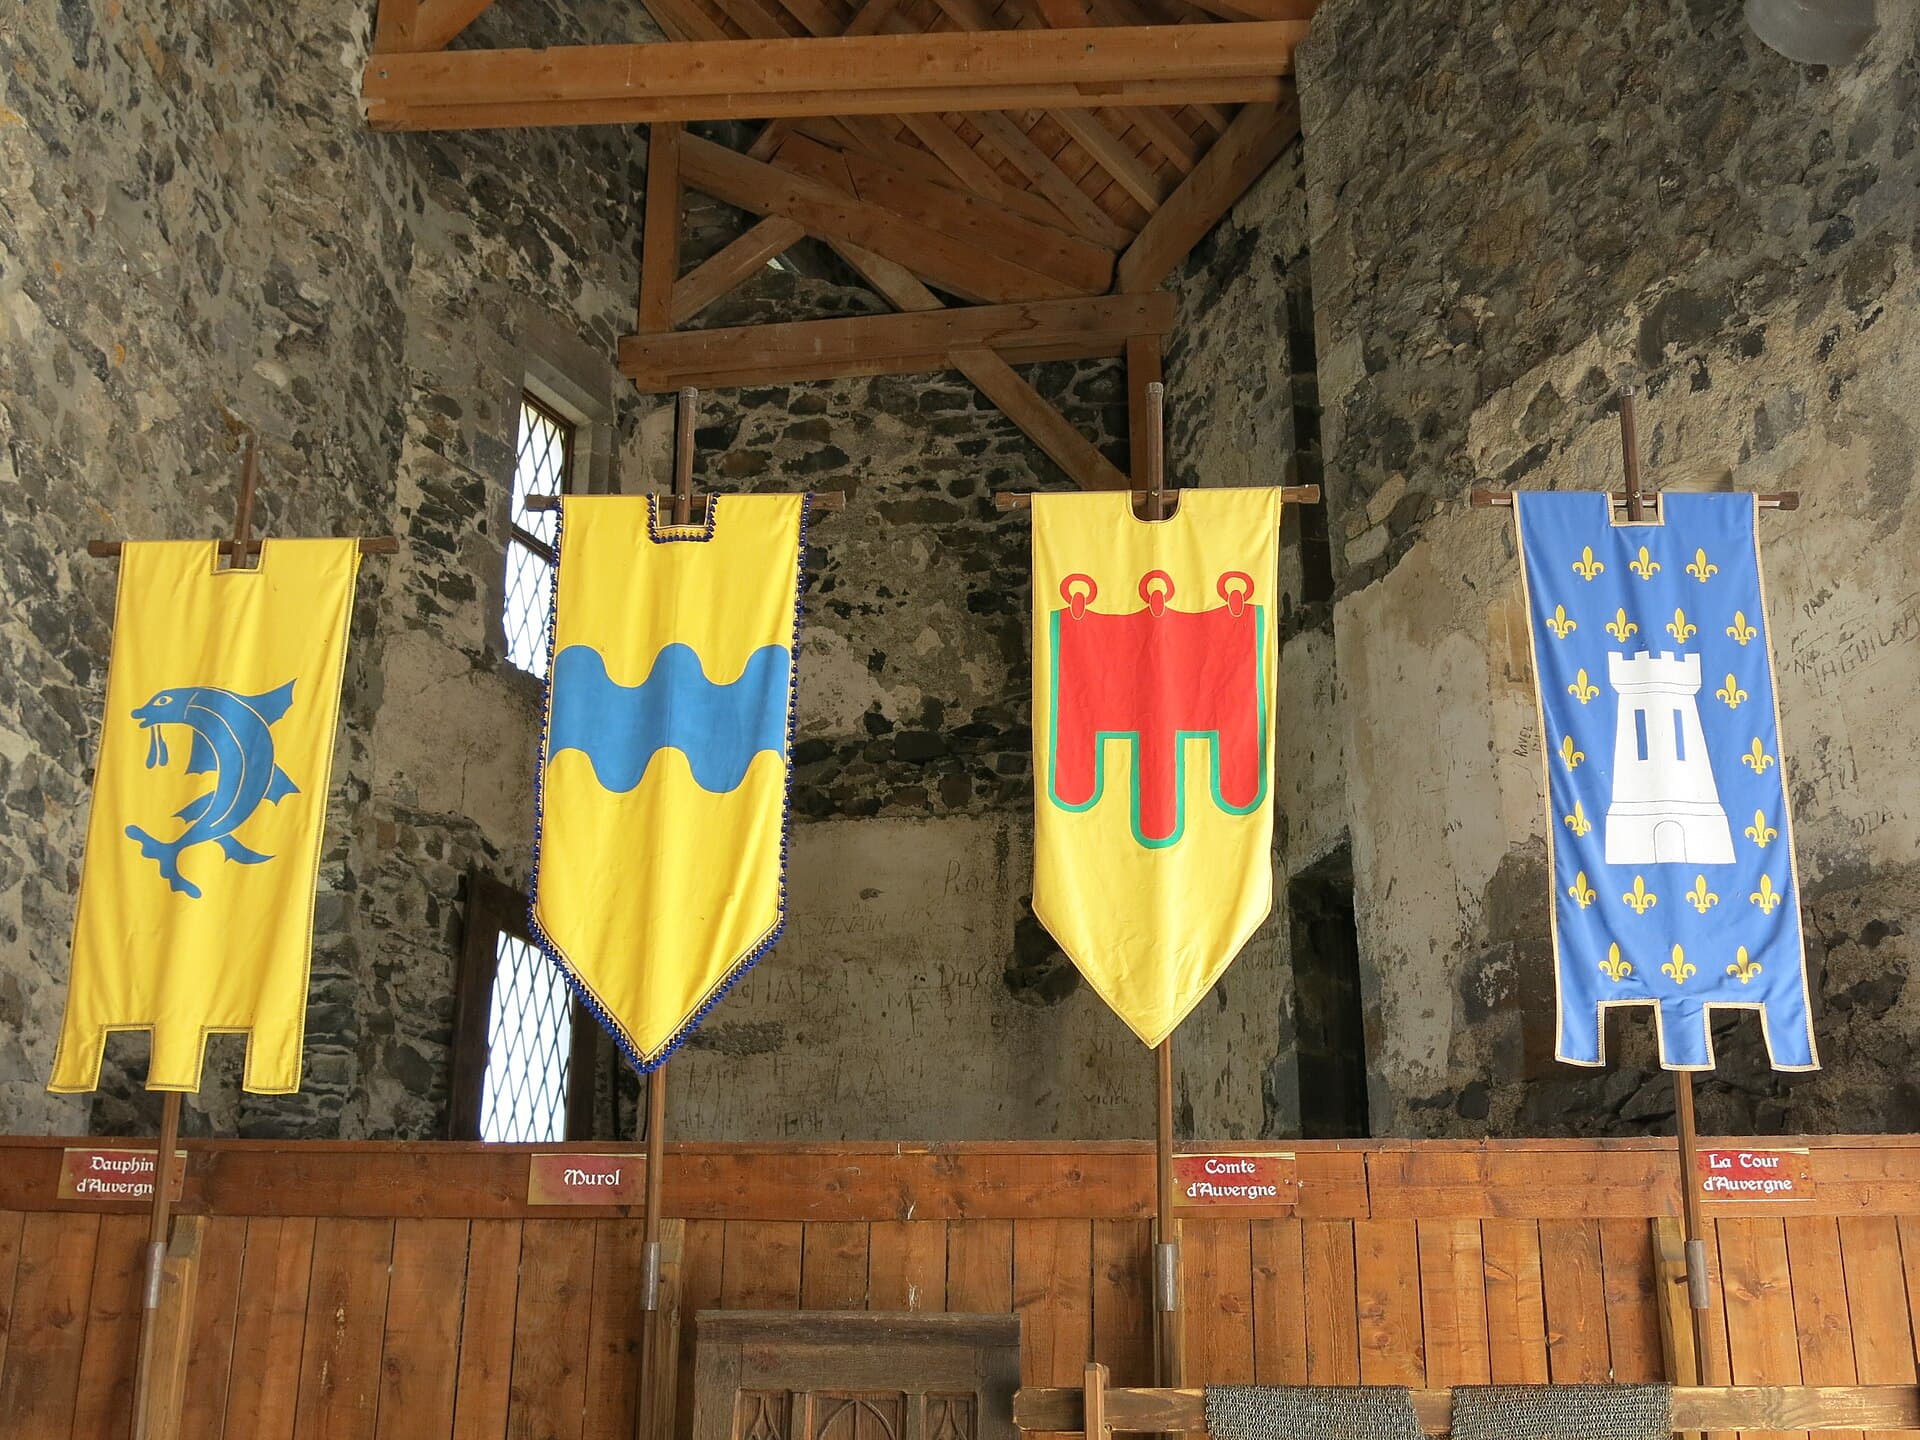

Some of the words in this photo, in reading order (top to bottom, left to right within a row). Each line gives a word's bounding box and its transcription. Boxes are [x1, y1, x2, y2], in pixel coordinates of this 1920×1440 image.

[89, 1156, 154, 1174] Dauphin
[1204, 1159, 1256, 1174] Comte
[1708, 1153, 1732, 1169] La
[1737, 1153, 1780, 1169] Tour
[563, 1168, 621, 1186] Murol
[1703, 1175, 1793, 1194] d'Auvergne
[76, 1178, 154, 1197] d'Auvergn
[1186, 1182, 1277, 1200] d'Auvergne
